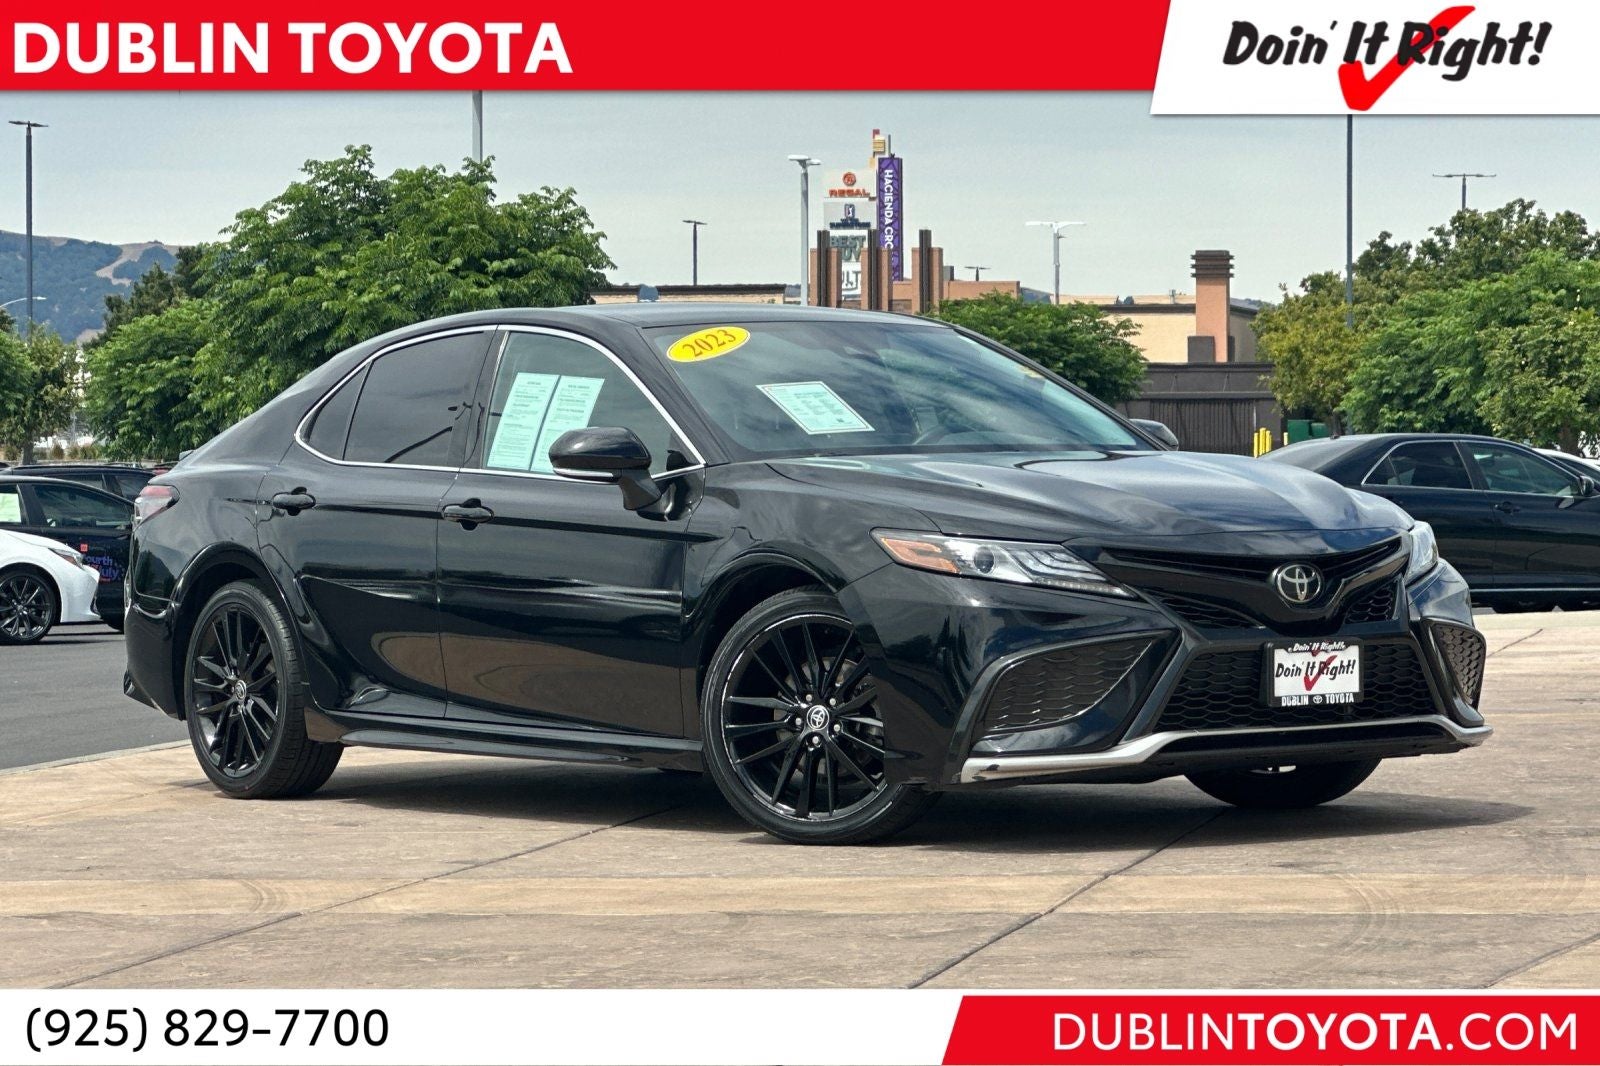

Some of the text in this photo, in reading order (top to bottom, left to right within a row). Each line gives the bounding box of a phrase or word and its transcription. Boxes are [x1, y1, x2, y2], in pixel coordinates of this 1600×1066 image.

[884, 169, 894, 225] HACIENDA
[830, 235, 867, 248] BEST
[682, 329, 736, 357] 2023
[84, 555, 113, 566] ourth
[1275, 659, 1356, 680] Doin' It Right!
[1281, 692, 1355, 707] DUBLIN TOYOTA
